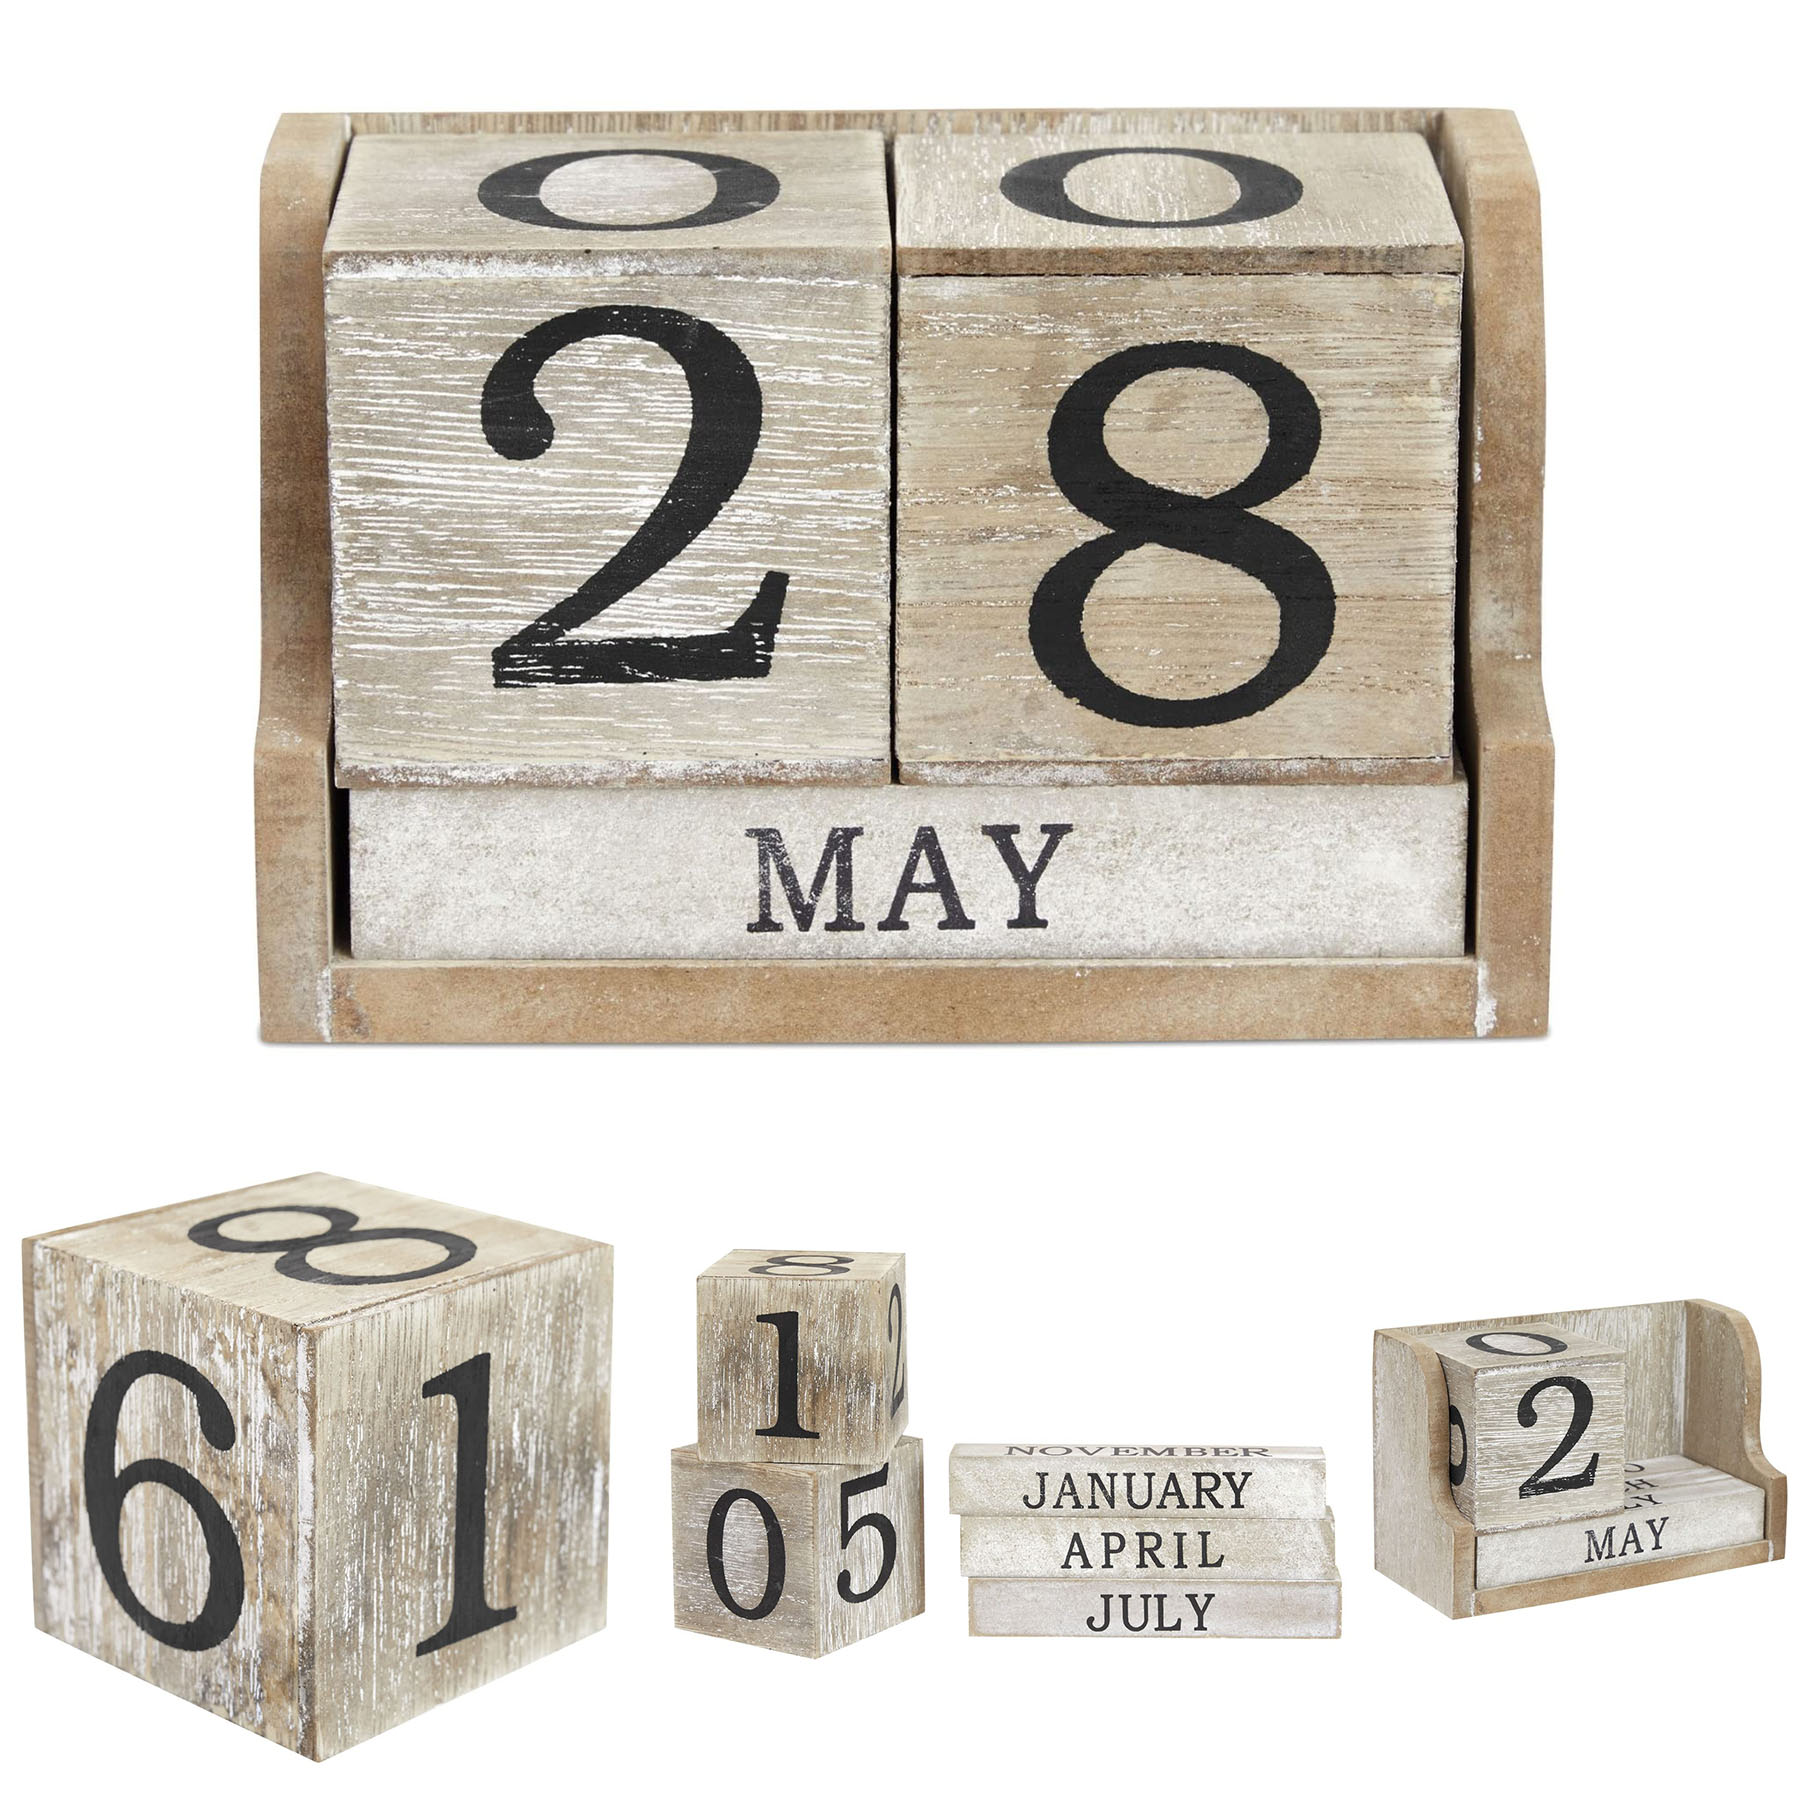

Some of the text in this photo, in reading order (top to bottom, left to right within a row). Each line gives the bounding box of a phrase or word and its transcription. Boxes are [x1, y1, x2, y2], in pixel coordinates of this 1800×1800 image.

[477, 148, 781, 229] 0
[999, 147, 1305, 229] 0
[480, 304, 790, 689] 2
[1028, 340, 1338, 729] 8
[746, 823, 1074, 933] MAY
[187, 1203, 478, 1285] 8
[747, 1253, 855, 1276] 8
[755, 1310, 820, 1440] 1
[888, 1283, 905, 1418] 2
[1465, 1332, 1568, 1356] 0
[1007, 1446, 1269, 1457] NOVEMBER
[1517, 1376, 1600, 1500] 2
[84, 1349, 245, 1652] 6
[416, 1352, 517, 1657] 1
[836, 1462, 897, 1604] 5
[1022, 1471, 1253, 1510] JANUARY
[706, 1488, 786, 1621] 0
[1060, 1530, 1225, 1569] APRIL
[1584, 1516, 1670, 1564] MAY
[1086, 1593, 1216, 1632] JULY
